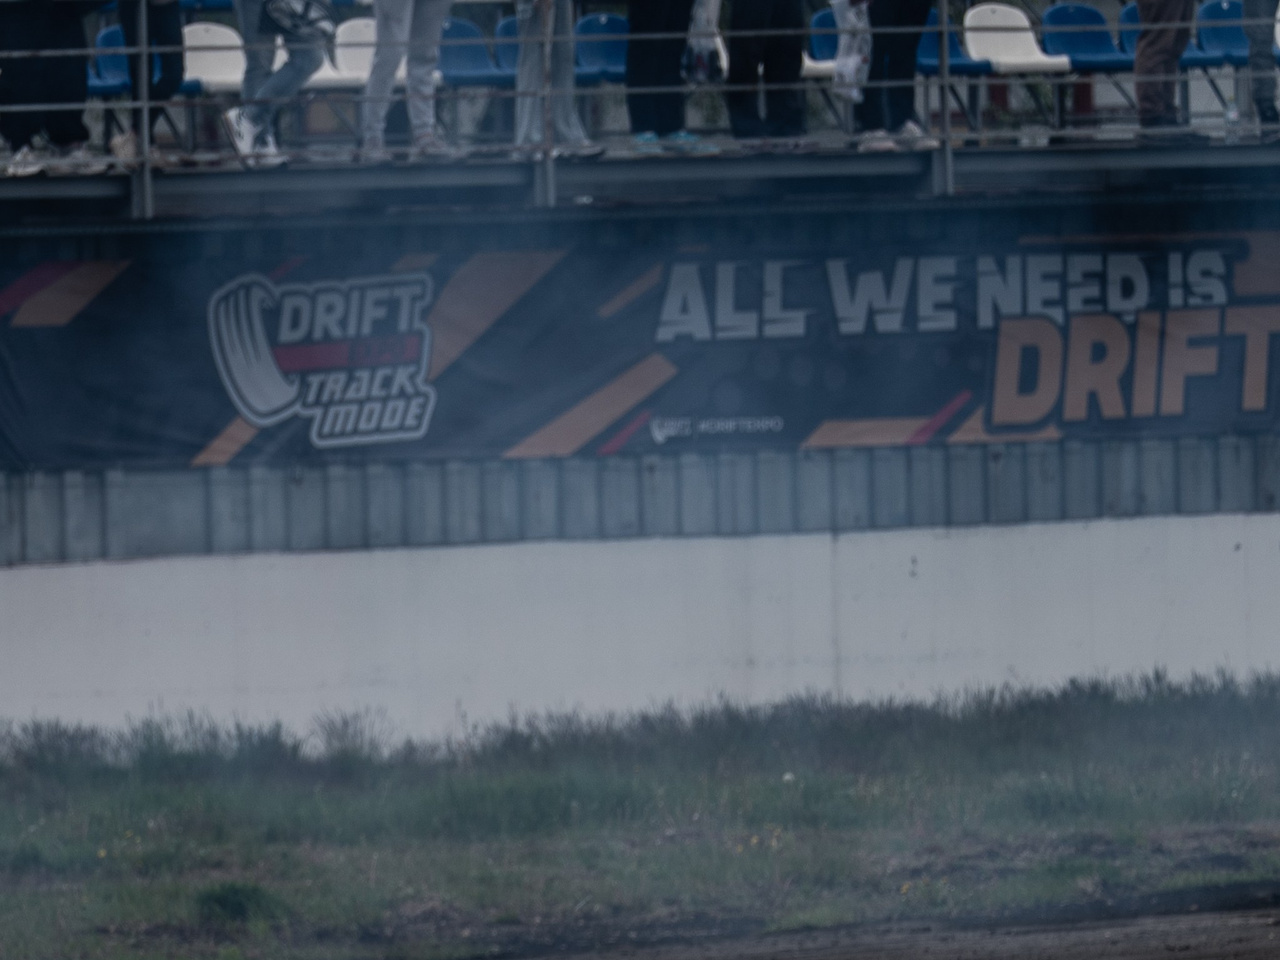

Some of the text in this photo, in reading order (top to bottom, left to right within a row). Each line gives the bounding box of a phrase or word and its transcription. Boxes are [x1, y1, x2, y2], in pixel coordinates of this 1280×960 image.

[277, 285, 422, 344] DRIFT
[655, 249, 1228, 341] ALL WE NEED IS
[305, 364, 420, 405] TRACK
[990, 304, 1280, 426] DRIFT
[322, 399, 426, 435] MODE
